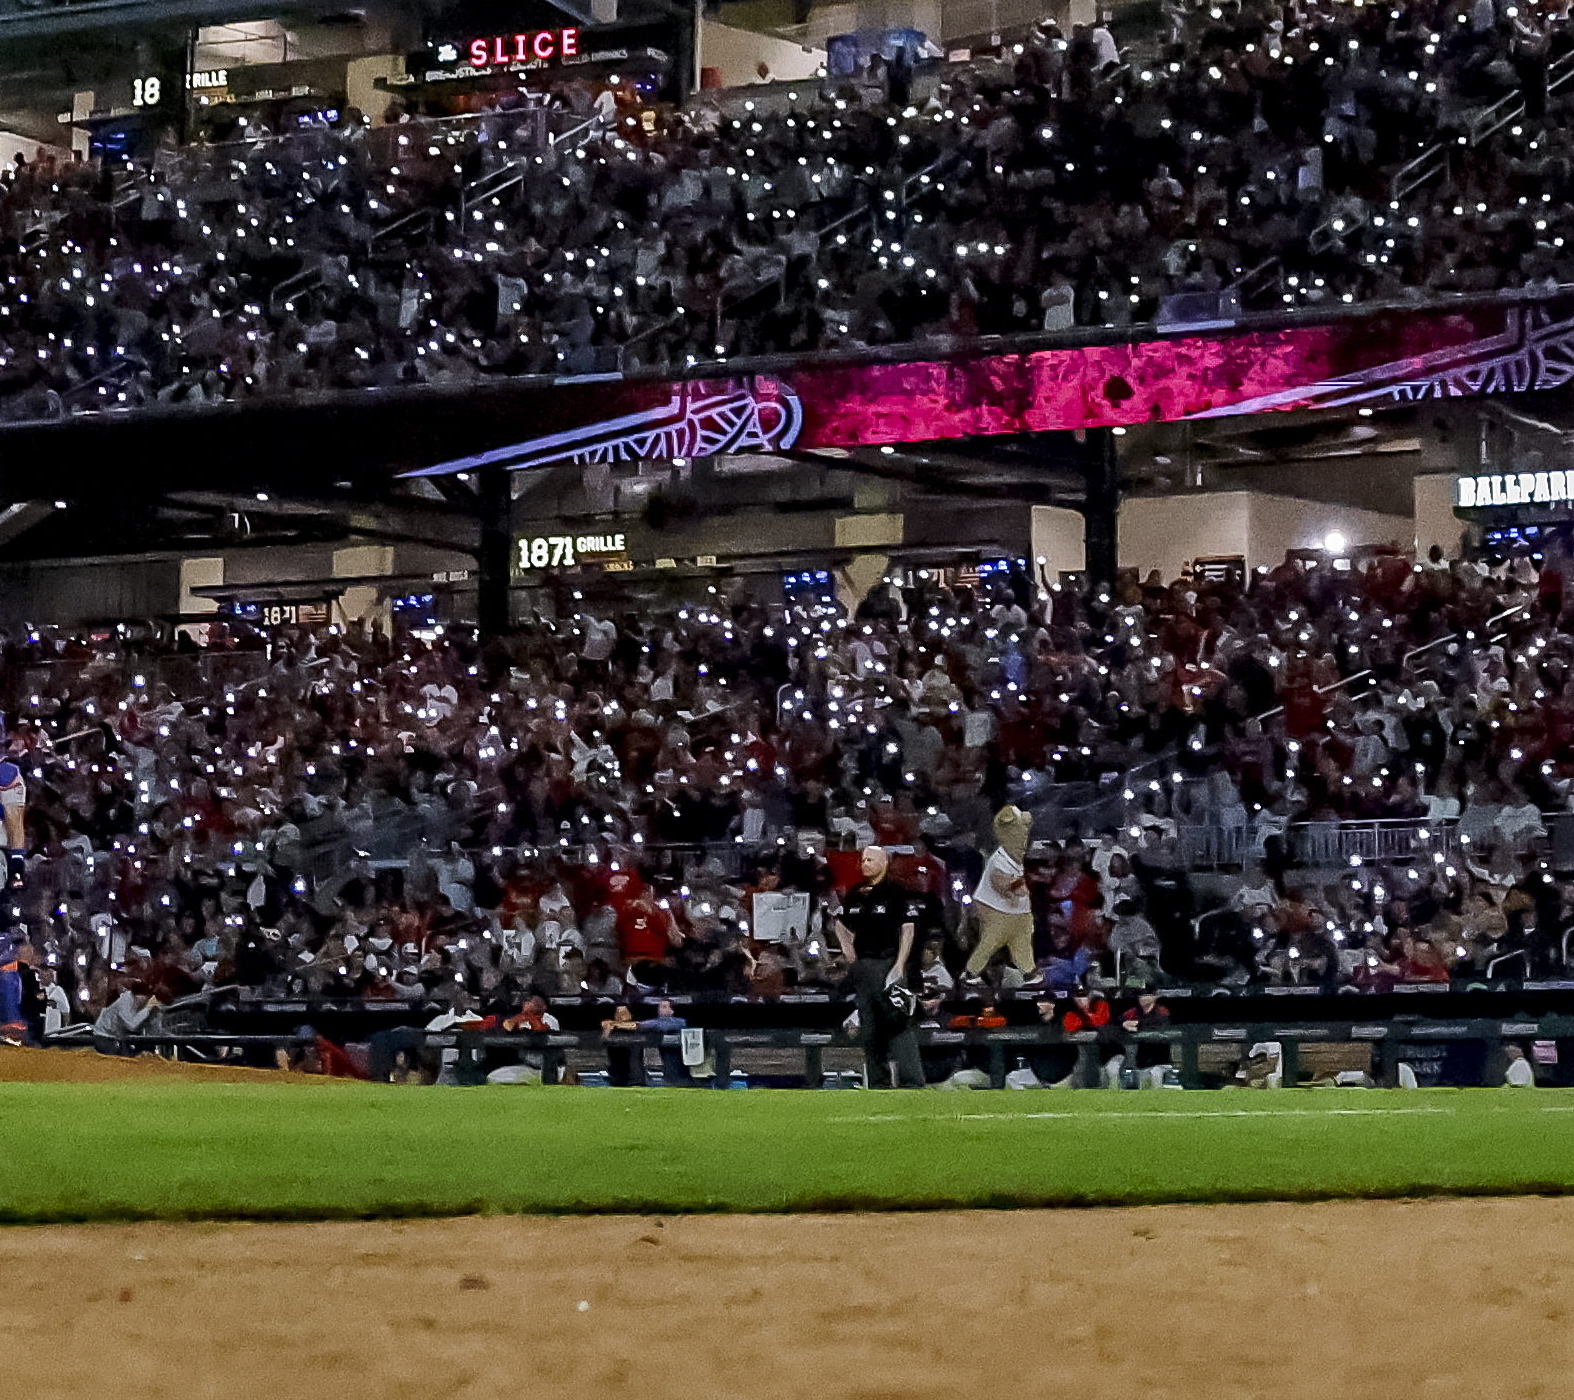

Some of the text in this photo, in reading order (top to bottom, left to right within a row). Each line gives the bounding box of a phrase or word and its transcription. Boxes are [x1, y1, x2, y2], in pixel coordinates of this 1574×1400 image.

[468, 27, 580, 67] SLICE
[518, 533, 626, 569] 1871 GRILLE
